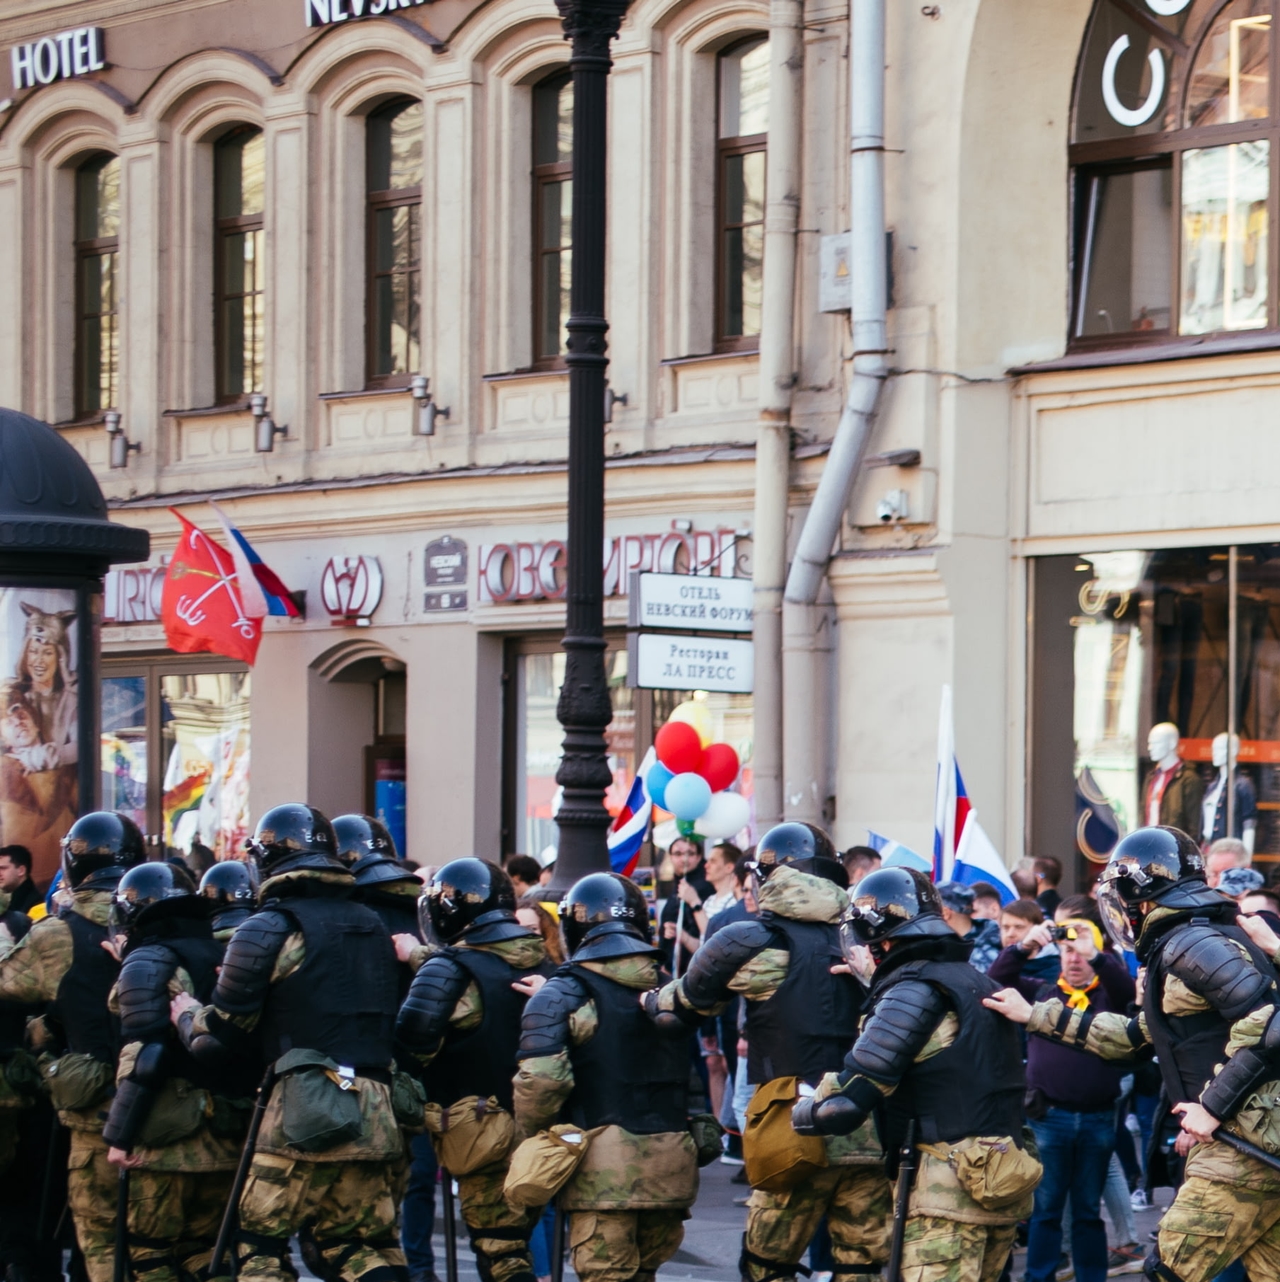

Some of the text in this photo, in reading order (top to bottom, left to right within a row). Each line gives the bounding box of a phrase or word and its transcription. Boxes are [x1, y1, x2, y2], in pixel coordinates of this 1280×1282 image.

[12, 27, 104, 89] HOTEL
[680, 585, 721, 601] ОТЕЛЬ
[646, 602, 706, 619] НЕВСКИЙ
[670, 644, 729, 662] Ресторан
[662, 664, 736, 681] ЛА ПРЕСС
